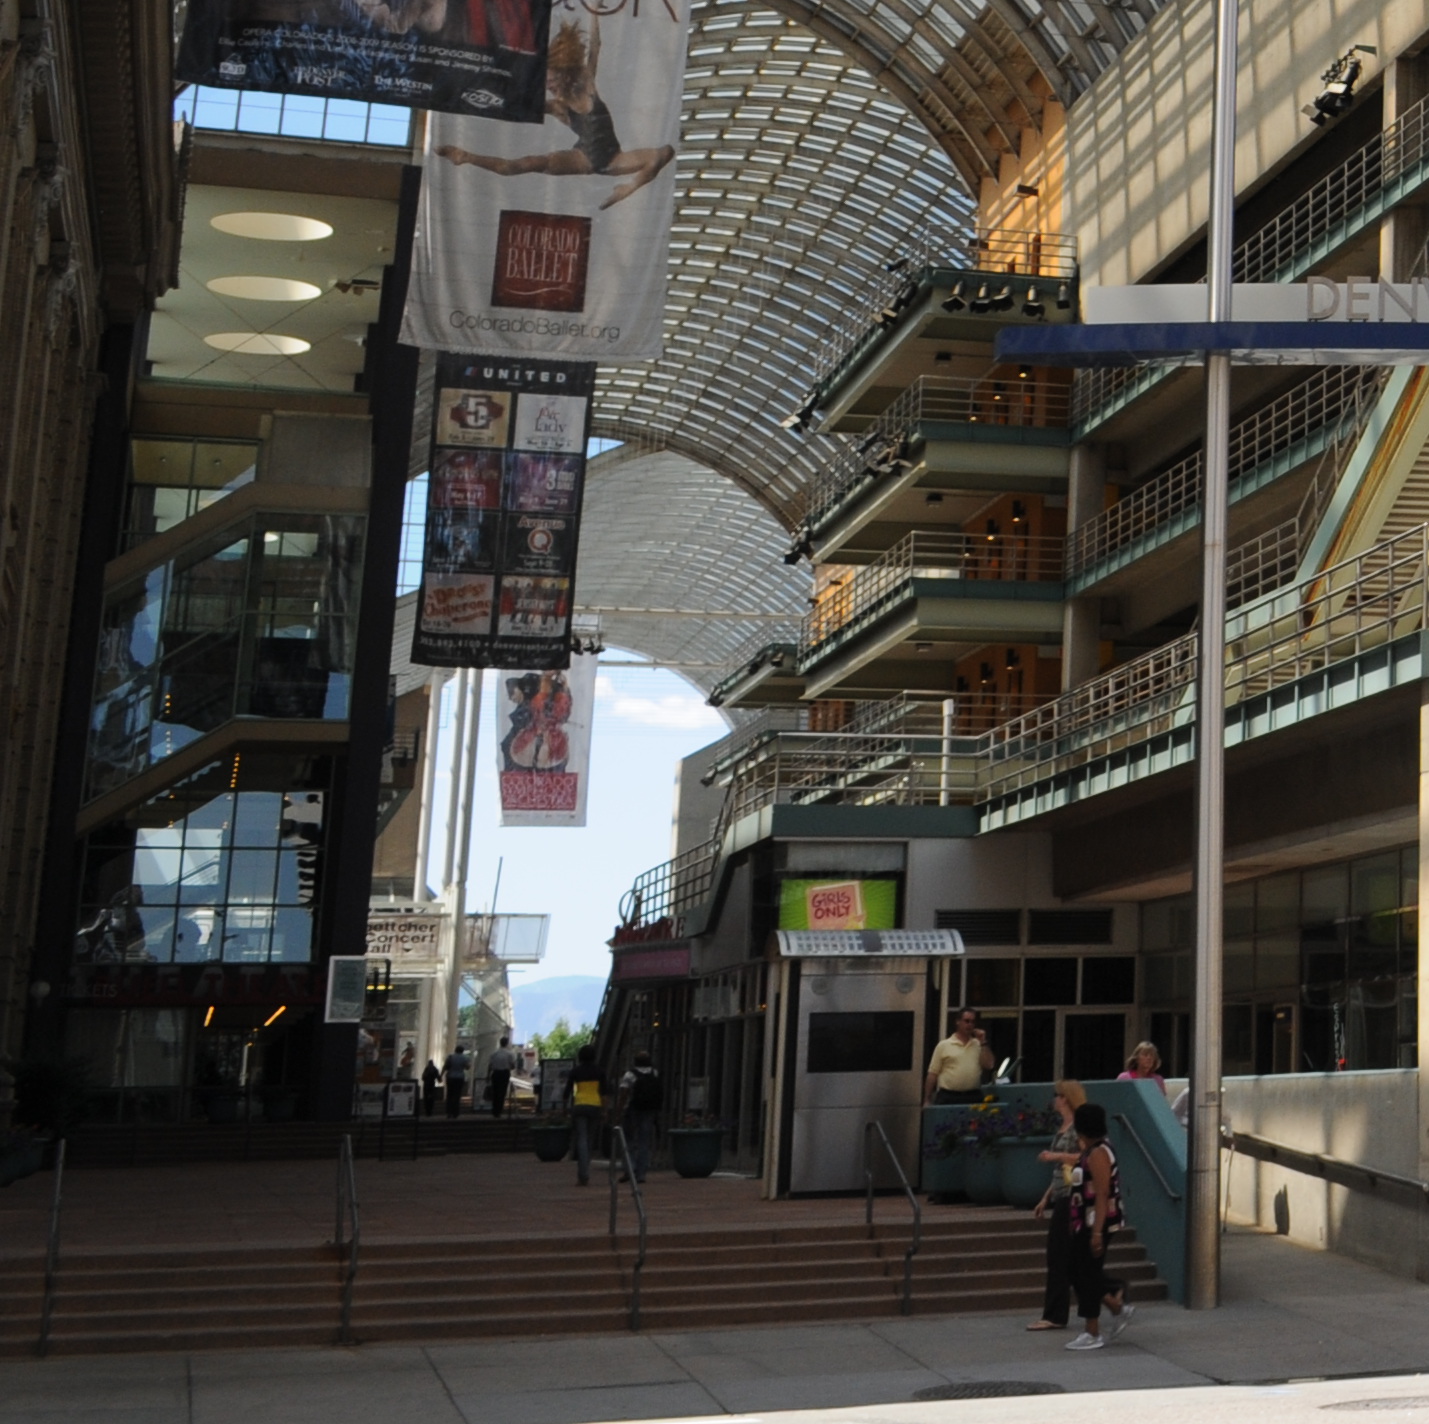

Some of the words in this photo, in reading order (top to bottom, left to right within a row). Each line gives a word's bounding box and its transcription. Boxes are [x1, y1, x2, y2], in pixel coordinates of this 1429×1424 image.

[508, 224, 581, 252] COLORADO
[505, 247, 578, 283] BALLET
[449, 309, 621, 344] ColoradoBallet.org
[483, 367, 567, 384] UNITED
[527, 526, 554, 555] Q
[812, 891, 852, 908] GIRLS
[814, 904, 851, 919] ONLY
[366, 931, 435, 944] Concert
